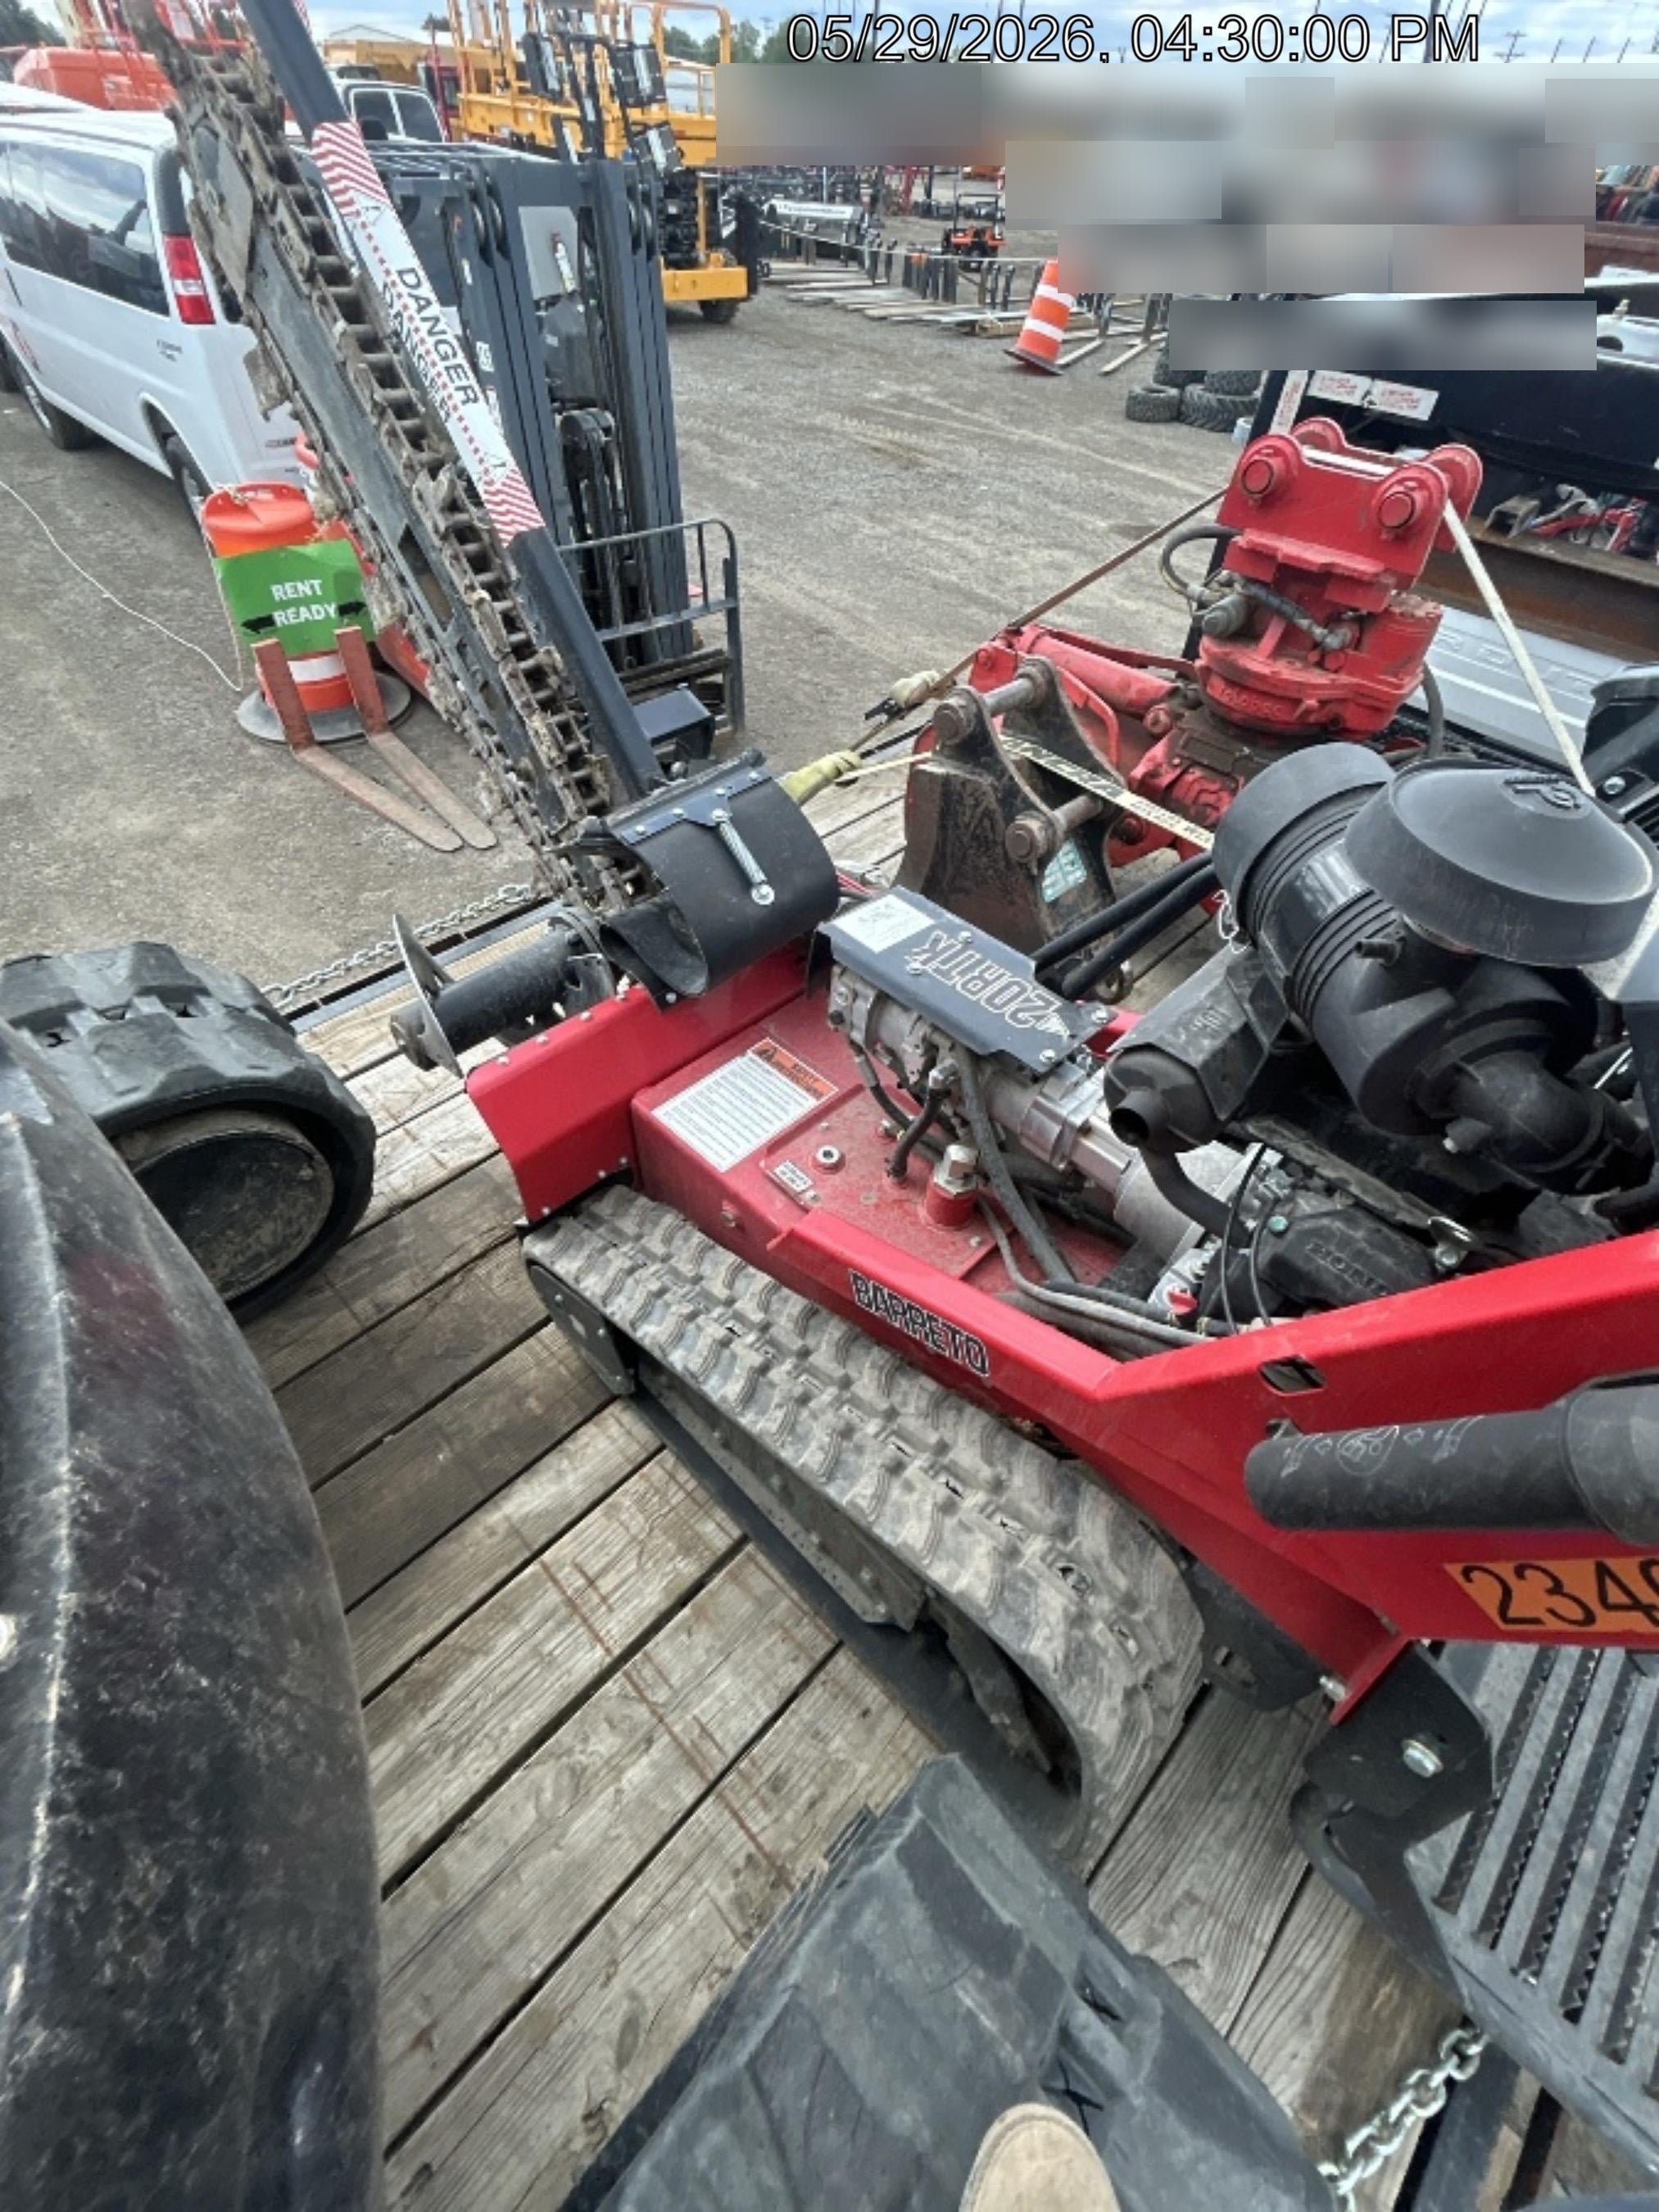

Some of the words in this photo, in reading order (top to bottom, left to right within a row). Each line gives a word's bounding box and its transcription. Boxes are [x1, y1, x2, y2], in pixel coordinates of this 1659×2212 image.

[395, 267, 480, 406] DANGER
[270, 578, 323, 602] RENT
[272, 602, 337, 628] READY
[904, 929, 1063, 1029] 20RTK
[848, 1268, 990, 1377] BARRETO
